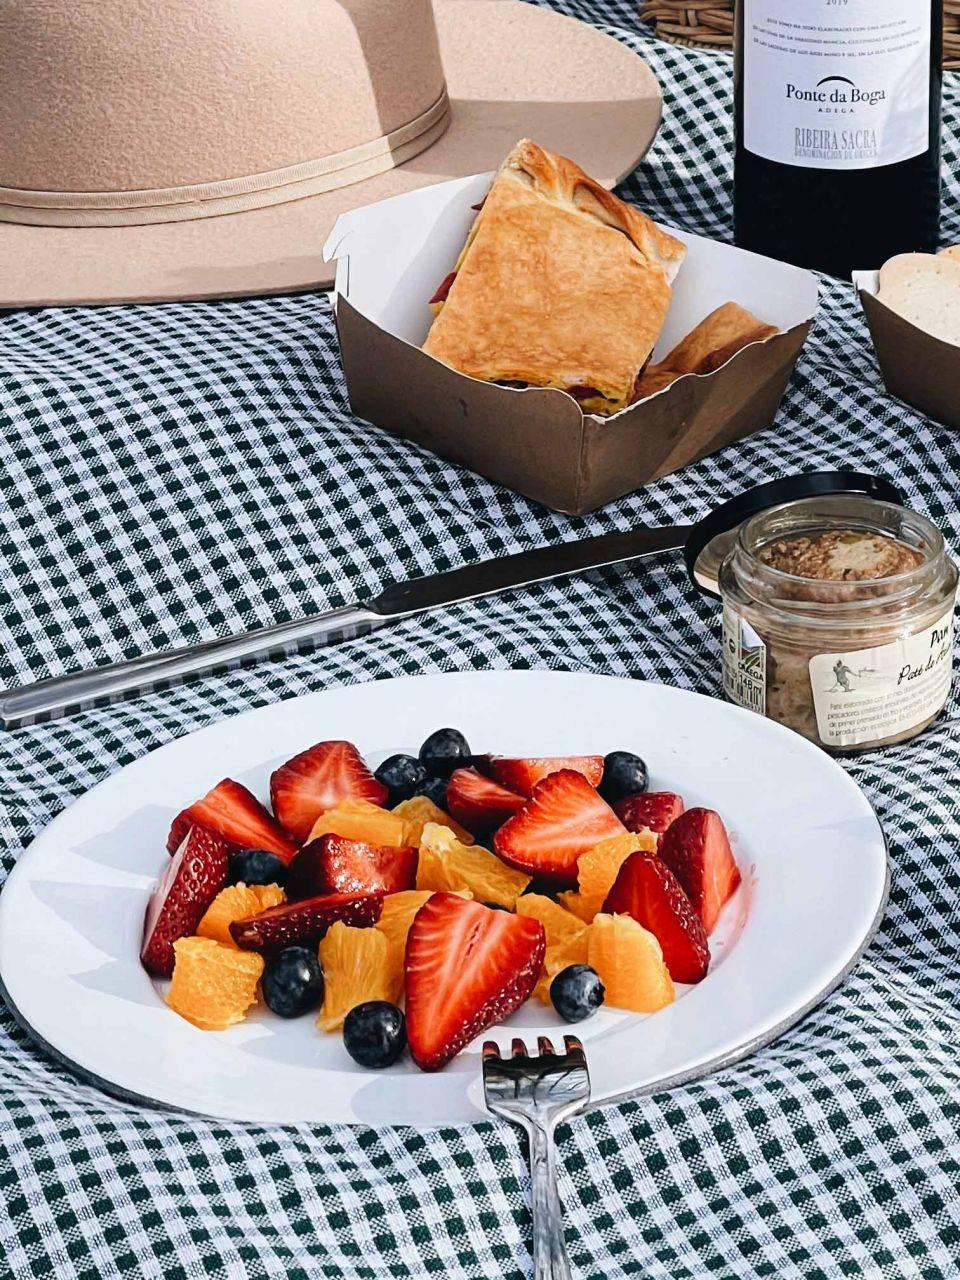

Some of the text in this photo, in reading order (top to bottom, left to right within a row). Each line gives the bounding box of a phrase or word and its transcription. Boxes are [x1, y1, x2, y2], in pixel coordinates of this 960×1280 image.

[786, 83, 886, 106] Ponte da Boga
[794, 127, 877, 150] RIBEIRA SACRA
